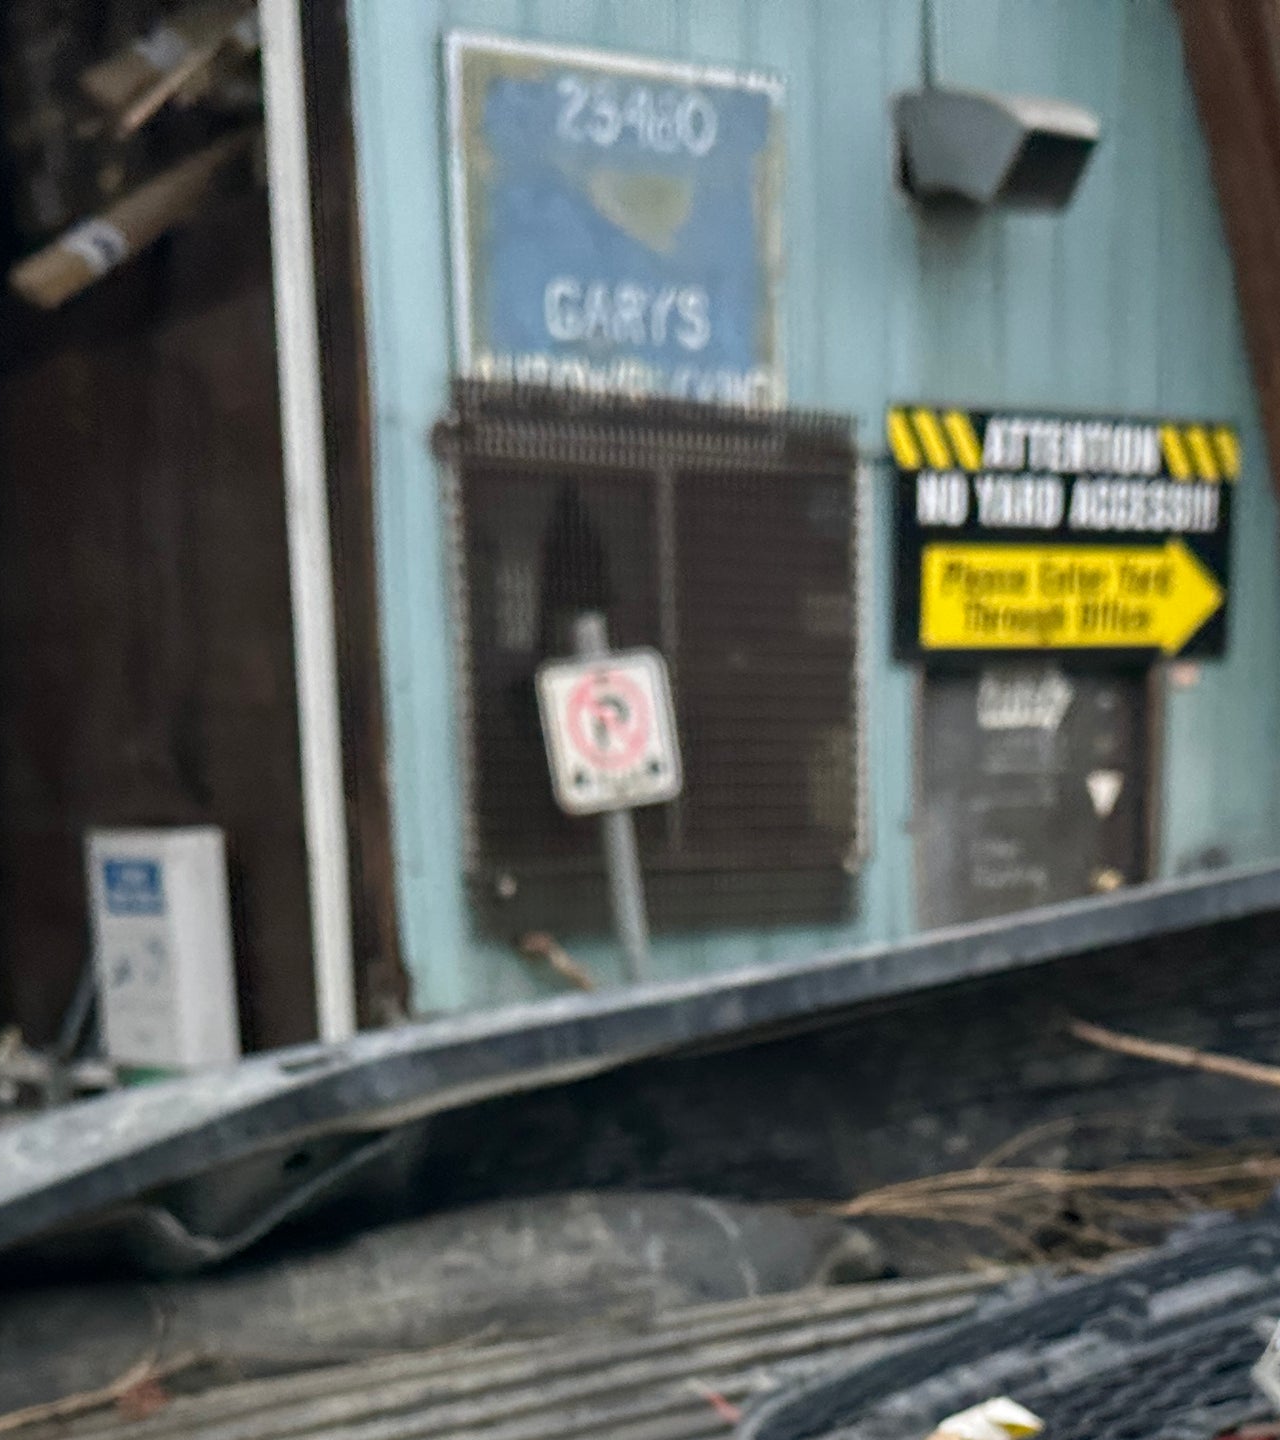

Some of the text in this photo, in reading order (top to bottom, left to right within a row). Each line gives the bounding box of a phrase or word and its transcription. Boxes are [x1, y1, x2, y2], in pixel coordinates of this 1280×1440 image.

[982, 415, 1161, 477] ATTENTION
[916, 472, 969, 527] NO
[973, 473, 1065, 529] YARD
